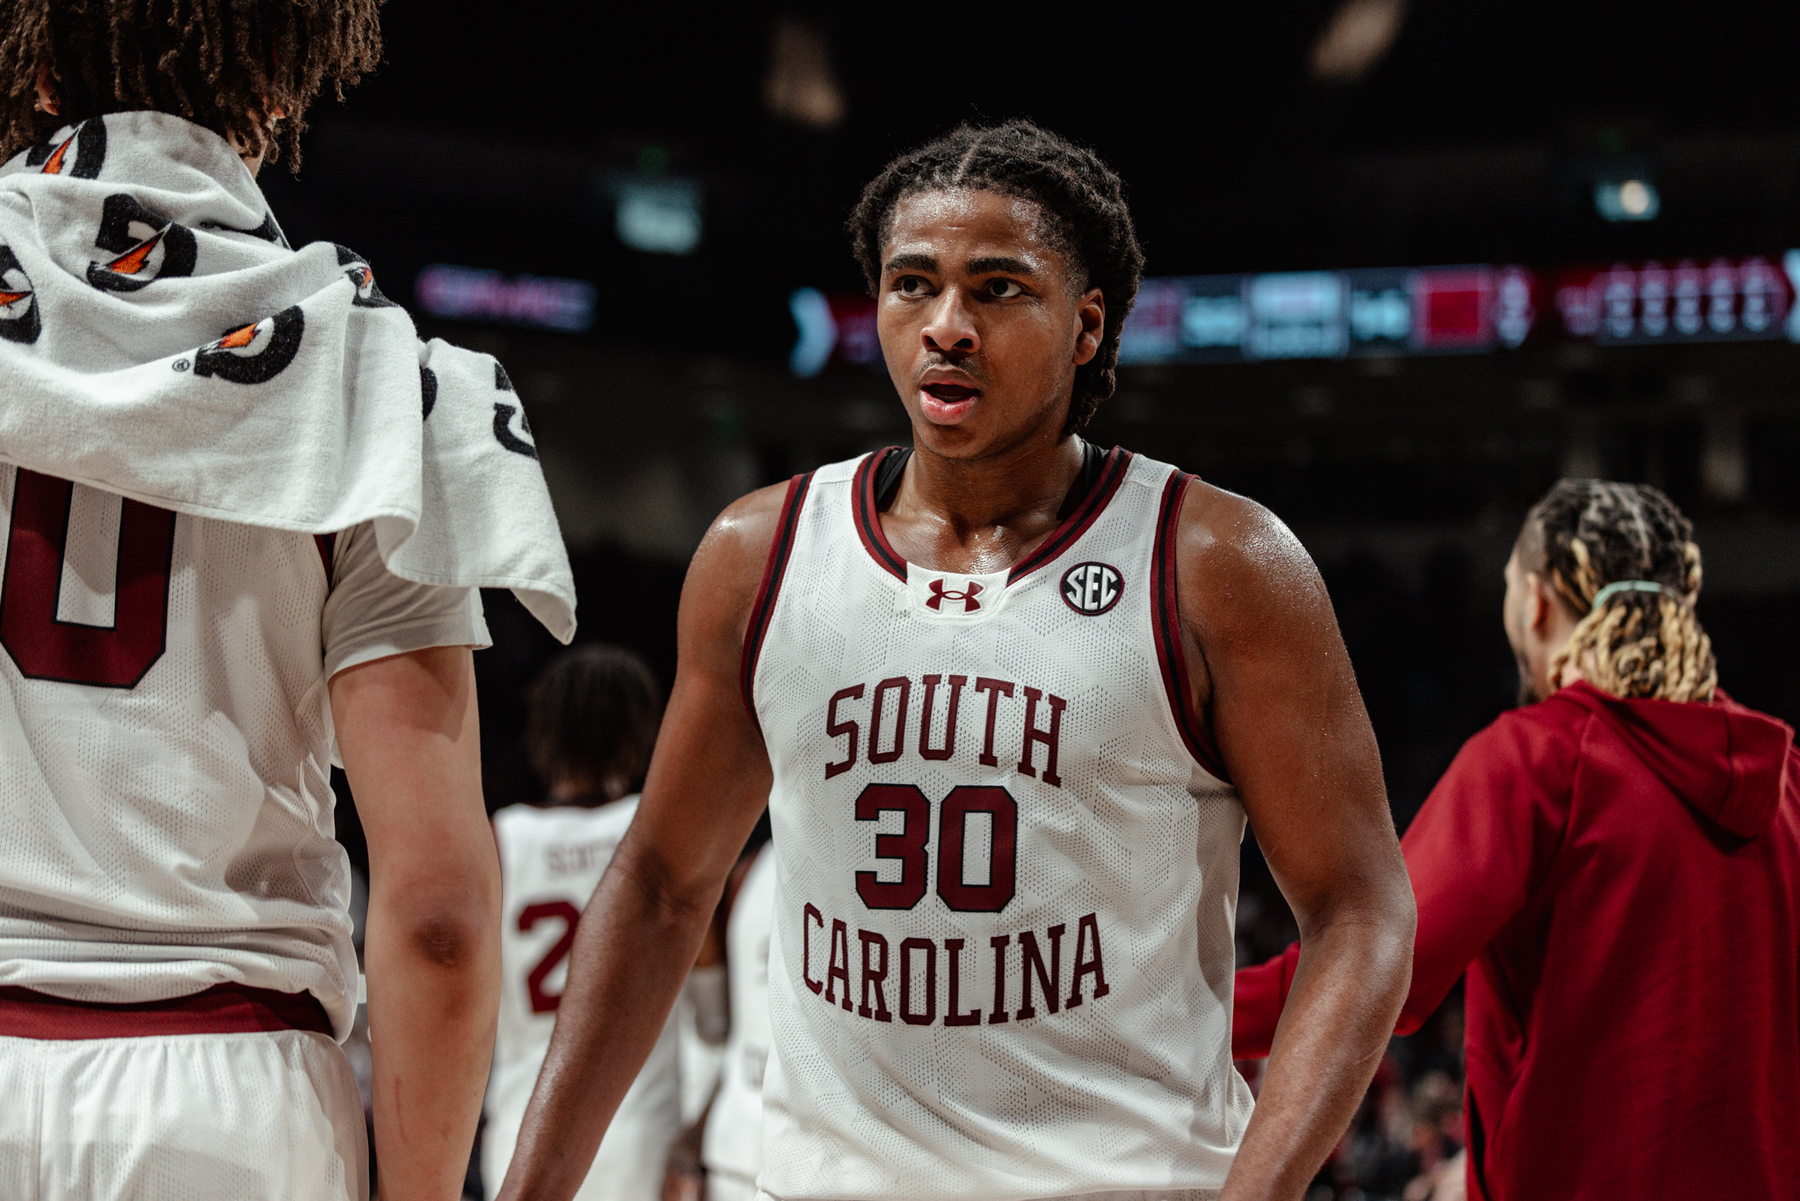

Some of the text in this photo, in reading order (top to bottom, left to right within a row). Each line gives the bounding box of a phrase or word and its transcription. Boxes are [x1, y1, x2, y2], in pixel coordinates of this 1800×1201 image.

[1065, 564, 1120, 612] SEC
[825, 673, 1067, 788] SOUTH
[855, 782, 1018, 913] 30
[803, 902, 1110, 1027] CAROLINA
